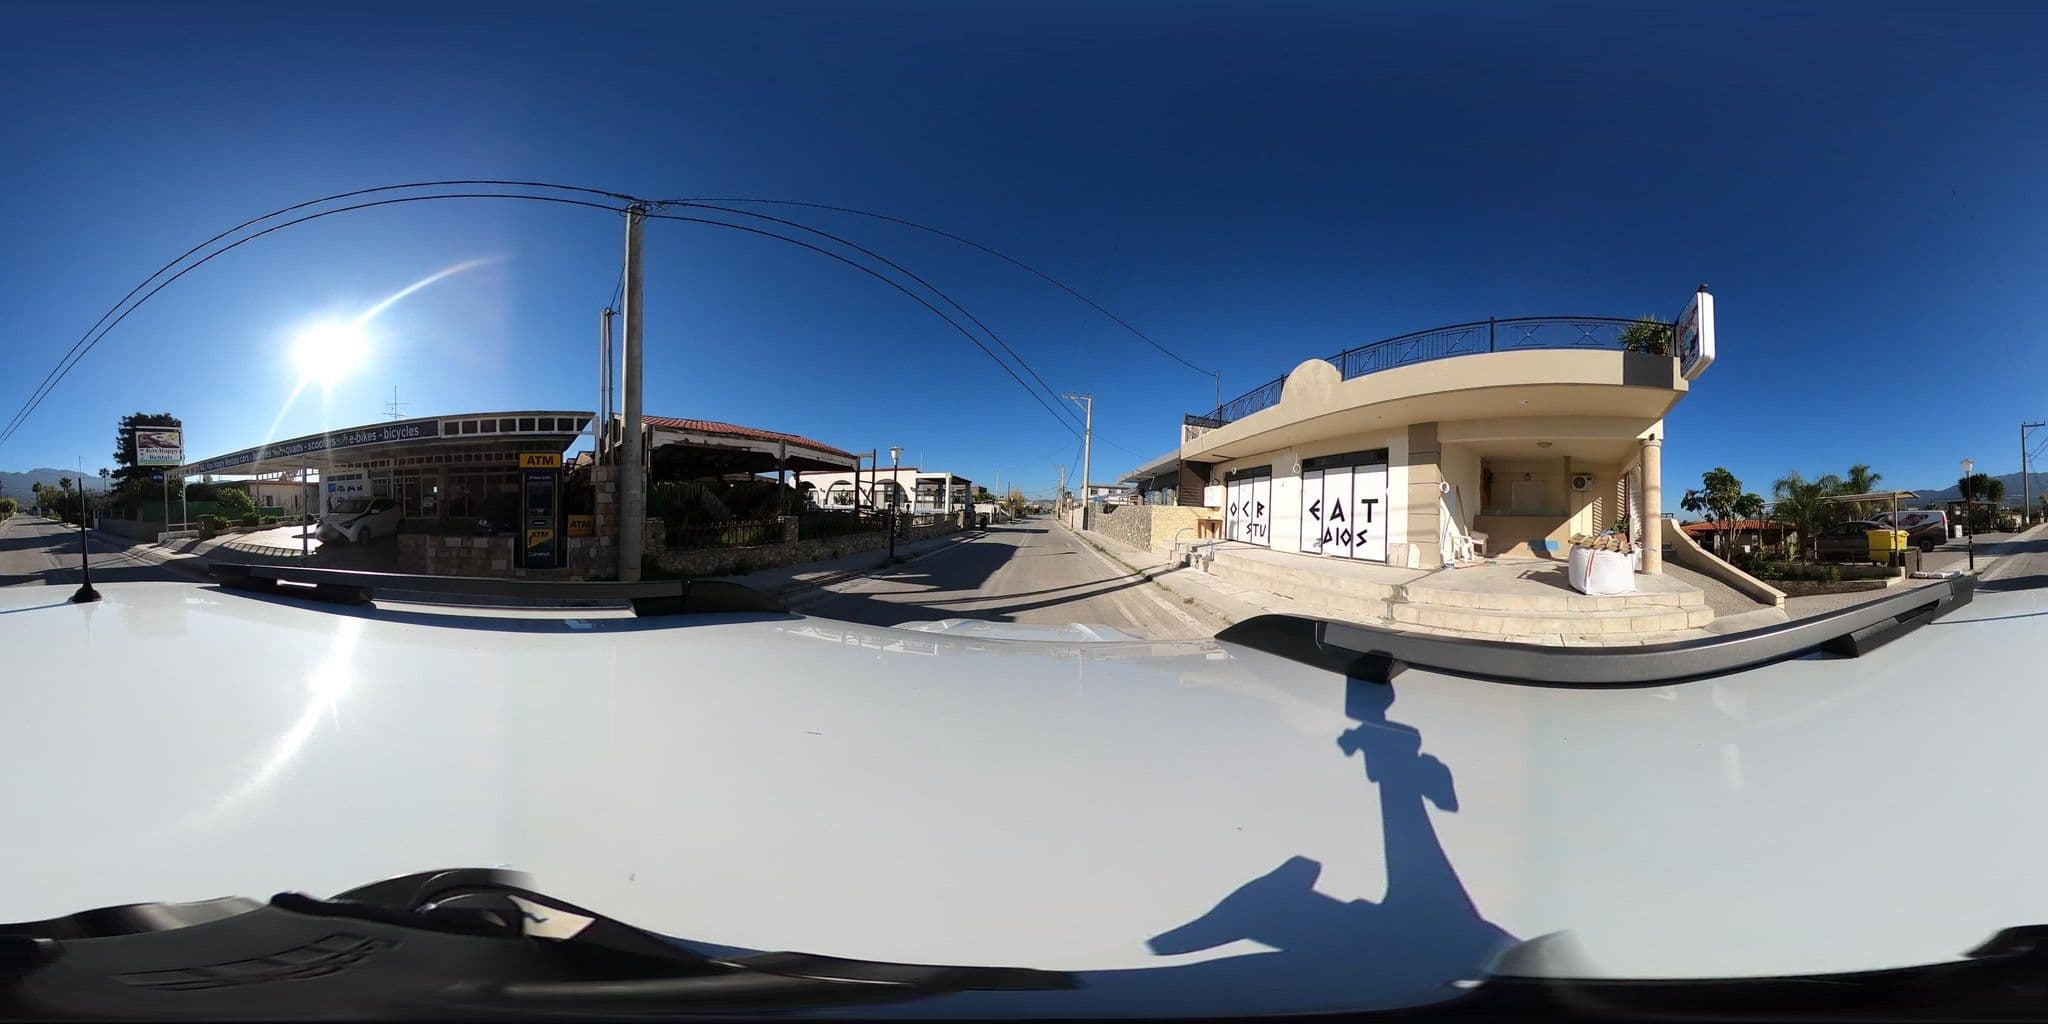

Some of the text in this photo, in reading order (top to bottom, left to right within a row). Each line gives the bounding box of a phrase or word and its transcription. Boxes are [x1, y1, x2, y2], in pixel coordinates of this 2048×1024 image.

[286, 444, 303, 456] quads
[349, 430, 377, 444] e-bikes
[383, 425, 420, 440] bicycles
[527, 455, 554, 466] ATM
[1309, 497, 1379, 523] EAT
[570, 520, 592, 529] ATM
[1246, 522, 1267, 538] STU
[531, 530, 549, 538] ATM
